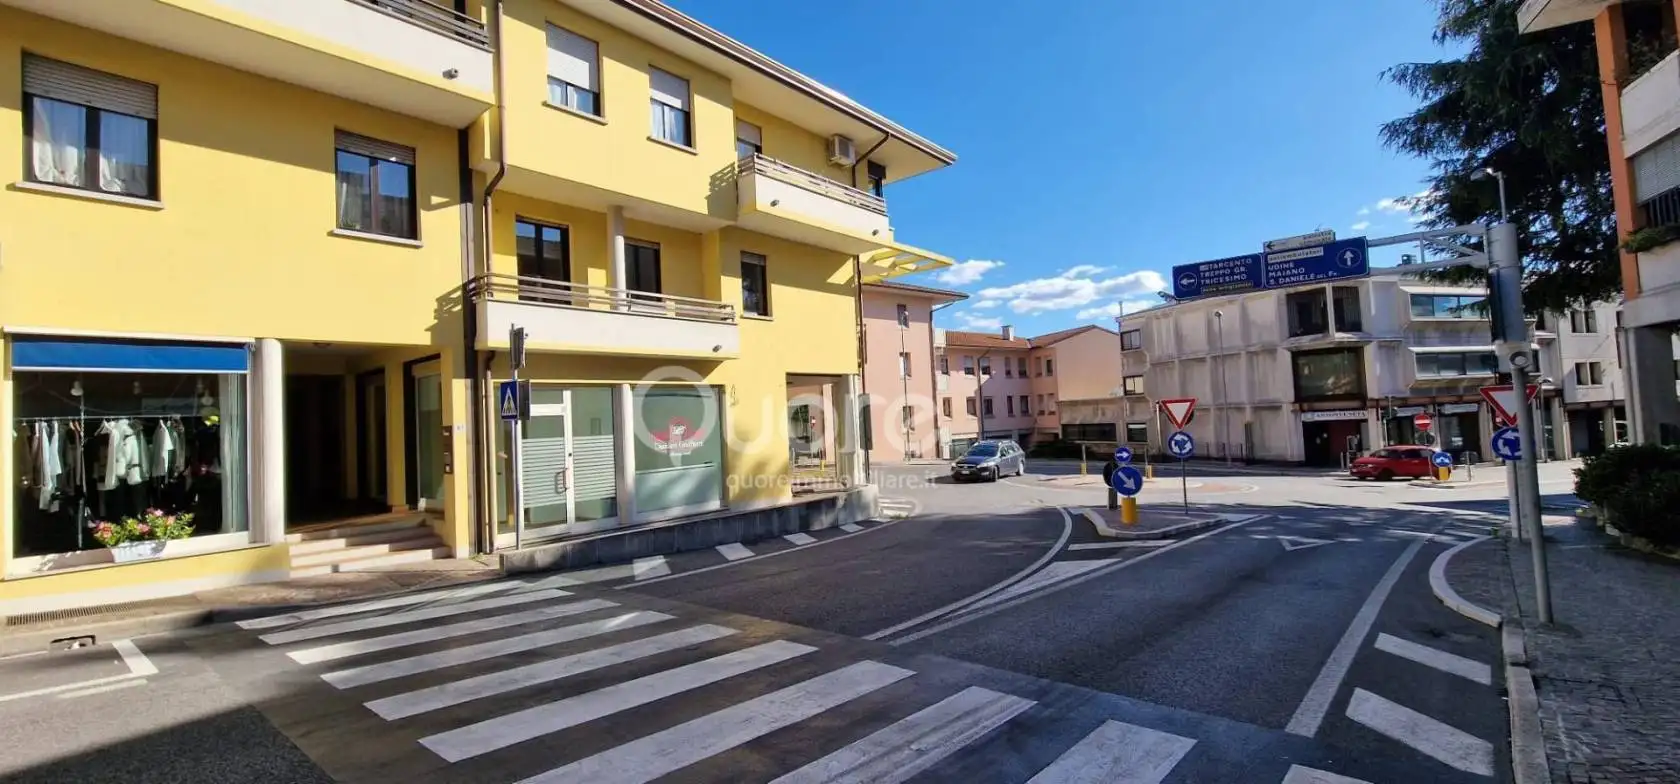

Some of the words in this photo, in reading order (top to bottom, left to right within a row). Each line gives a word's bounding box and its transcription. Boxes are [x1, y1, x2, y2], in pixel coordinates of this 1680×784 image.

[1268, 262, 1295, 271] UDINE
[1268, 267, 1305, 278] MAIANO
[1201, 273, 1247, 285] TRICESIMO
[1279, 273, 1316, 285] DANIELE
